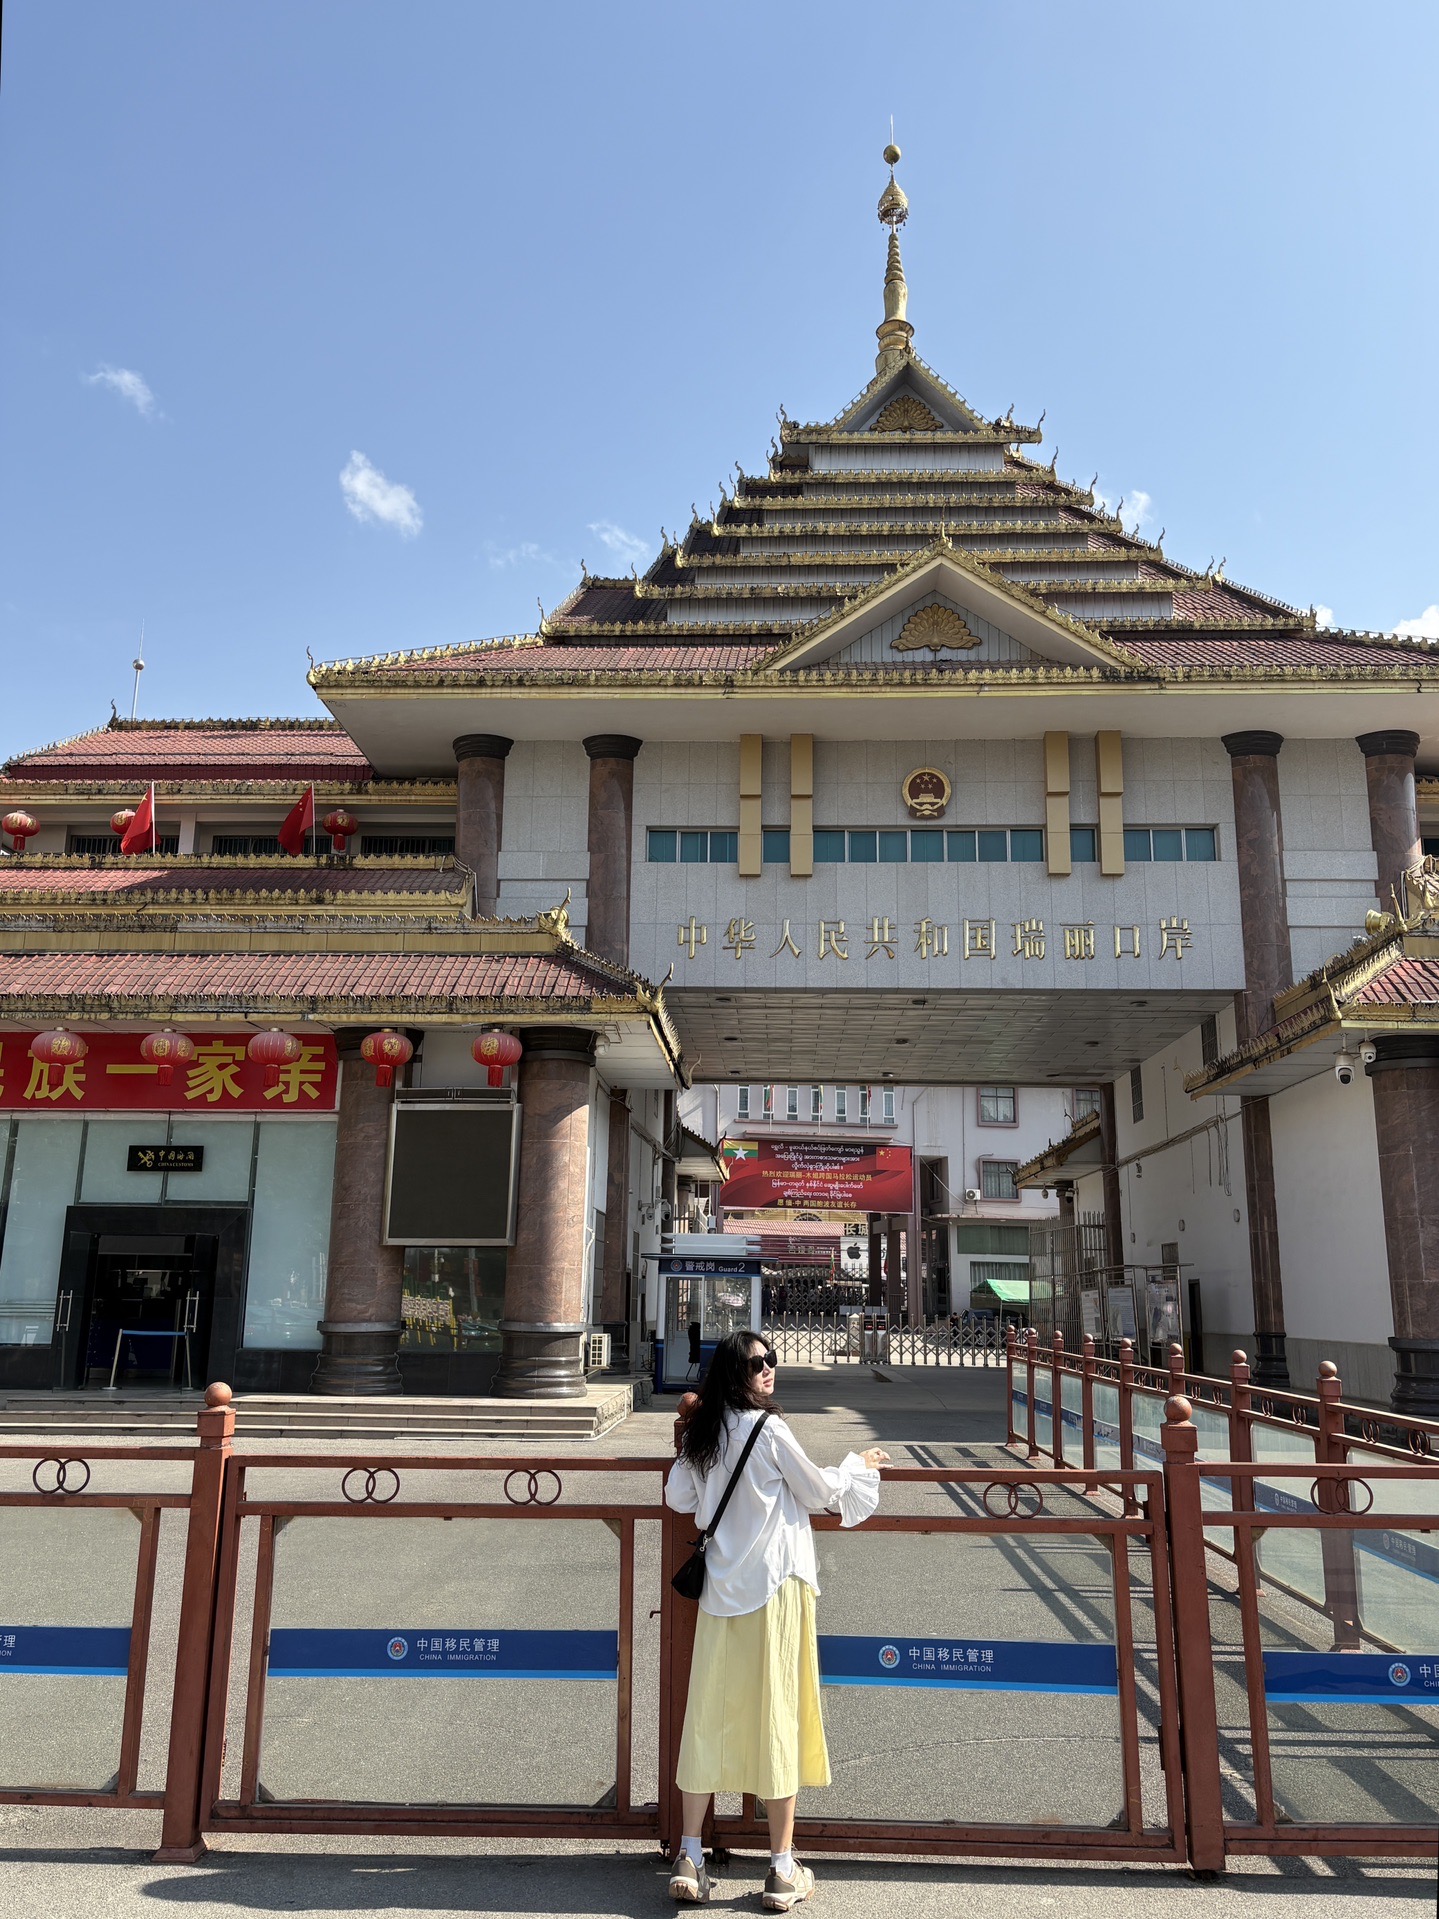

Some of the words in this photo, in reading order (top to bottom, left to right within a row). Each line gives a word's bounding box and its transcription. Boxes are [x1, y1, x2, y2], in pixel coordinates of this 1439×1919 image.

[677, 916, 1193, 961] 中华人民共和国瑞丽口岸
[685, 1261, 715, 1272] 警戒岗
[417, 1638, 500, 1652] 中国移民管理
[909, 1646, 994, 1664] 中国移民管理
[940, 1664, 992, 1672] IMMIGRATION
